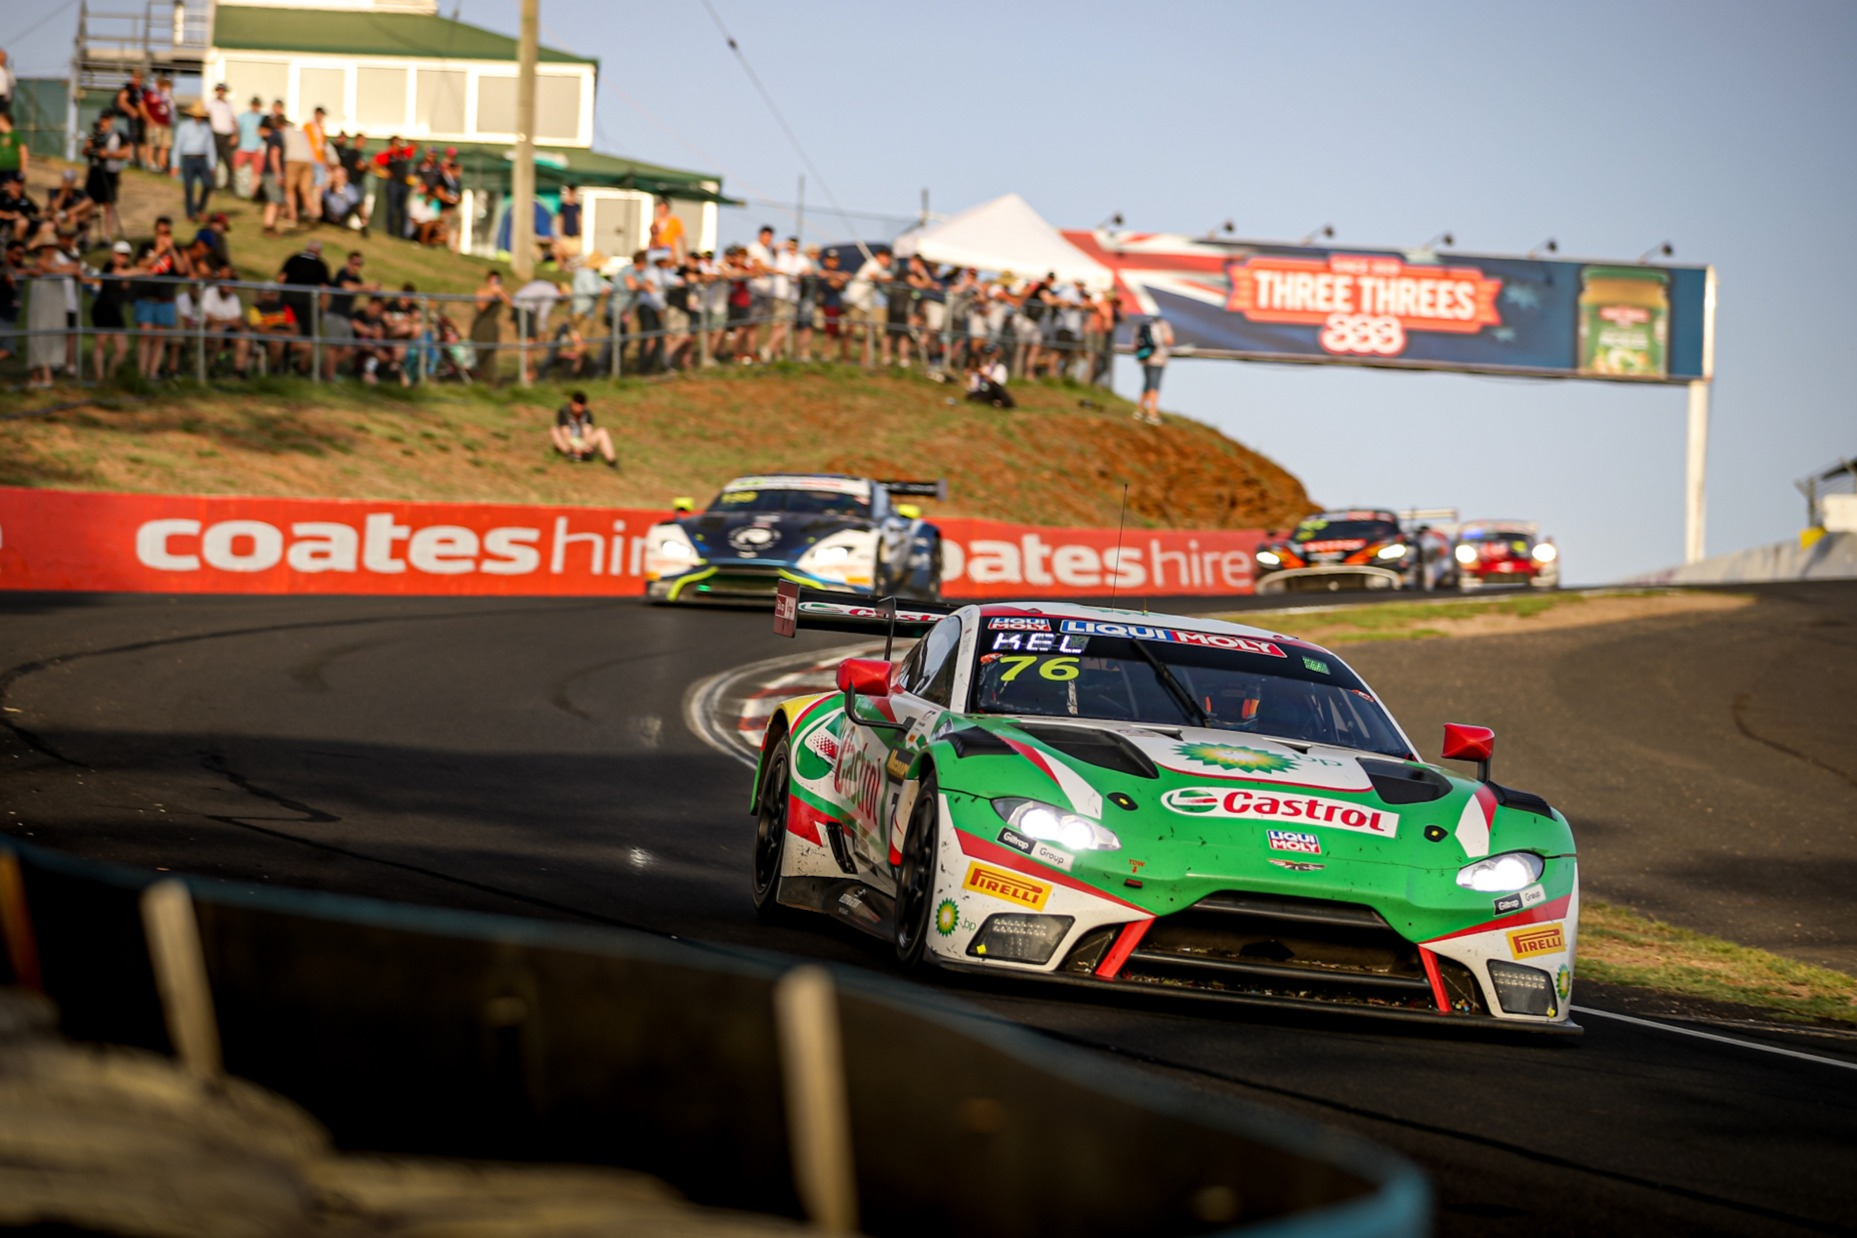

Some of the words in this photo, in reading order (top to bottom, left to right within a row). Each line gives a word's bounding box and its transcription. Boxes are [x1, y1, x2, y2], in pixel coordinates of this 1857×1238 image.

[1253, 269, 1355, 313] THREE
[1357, 276, 1477, 321] THREES
[550, 516, 647, 577] hir
[992, 623, 1050, 632] MOLY
[1067, 620, 1165, 640] LIQUI
[1177, 632, 1272, 654] MOLY
[1000, 655, 1080, 681] 76
[1292, 753, 1342, 767] bp
[1223, 791, 1385, 831] Castrol
[1269, 830, 1316, 845] LIQUI
[1271, 839, 1318, 852] MOLY
[1039, 847, 1065, 865] Group
[1128, 858, 1145, 867] TOW
[969, 868, 1044, 904] PIRELLI
[963, 917, 976, 932] bp
[1512, 929, 1562, 954] PIRELLI
